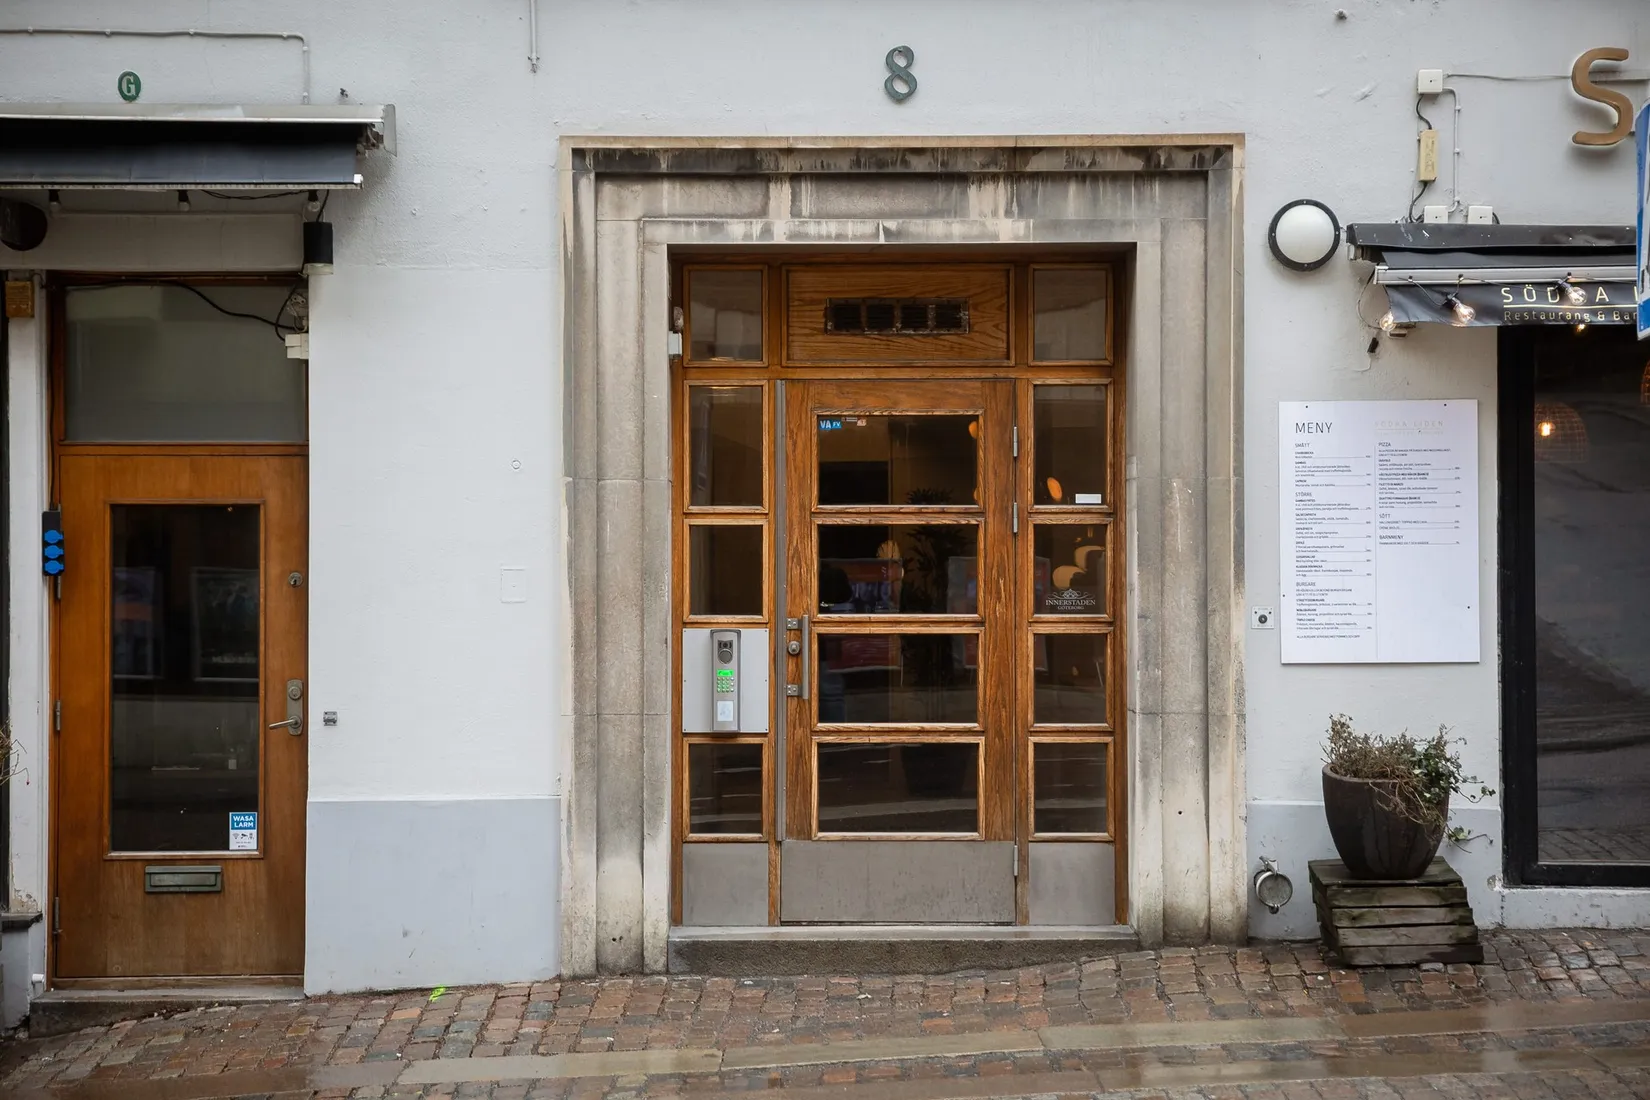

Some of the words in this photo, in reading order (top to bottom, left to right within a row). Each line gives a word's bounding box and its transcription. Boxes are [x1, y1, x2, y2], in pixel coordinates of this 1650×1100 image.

[884, 45, 917, 101] 8
[121, 75, 136, 97] G
[1571, 46, 1633, 146] S
[1501, 285, 1610, 303] SÖDA
[1503, 310, 1591, 323] Restaurang
[1597, 311, 1606, 321] &
[1295, 422, 1333, 434] MENY
